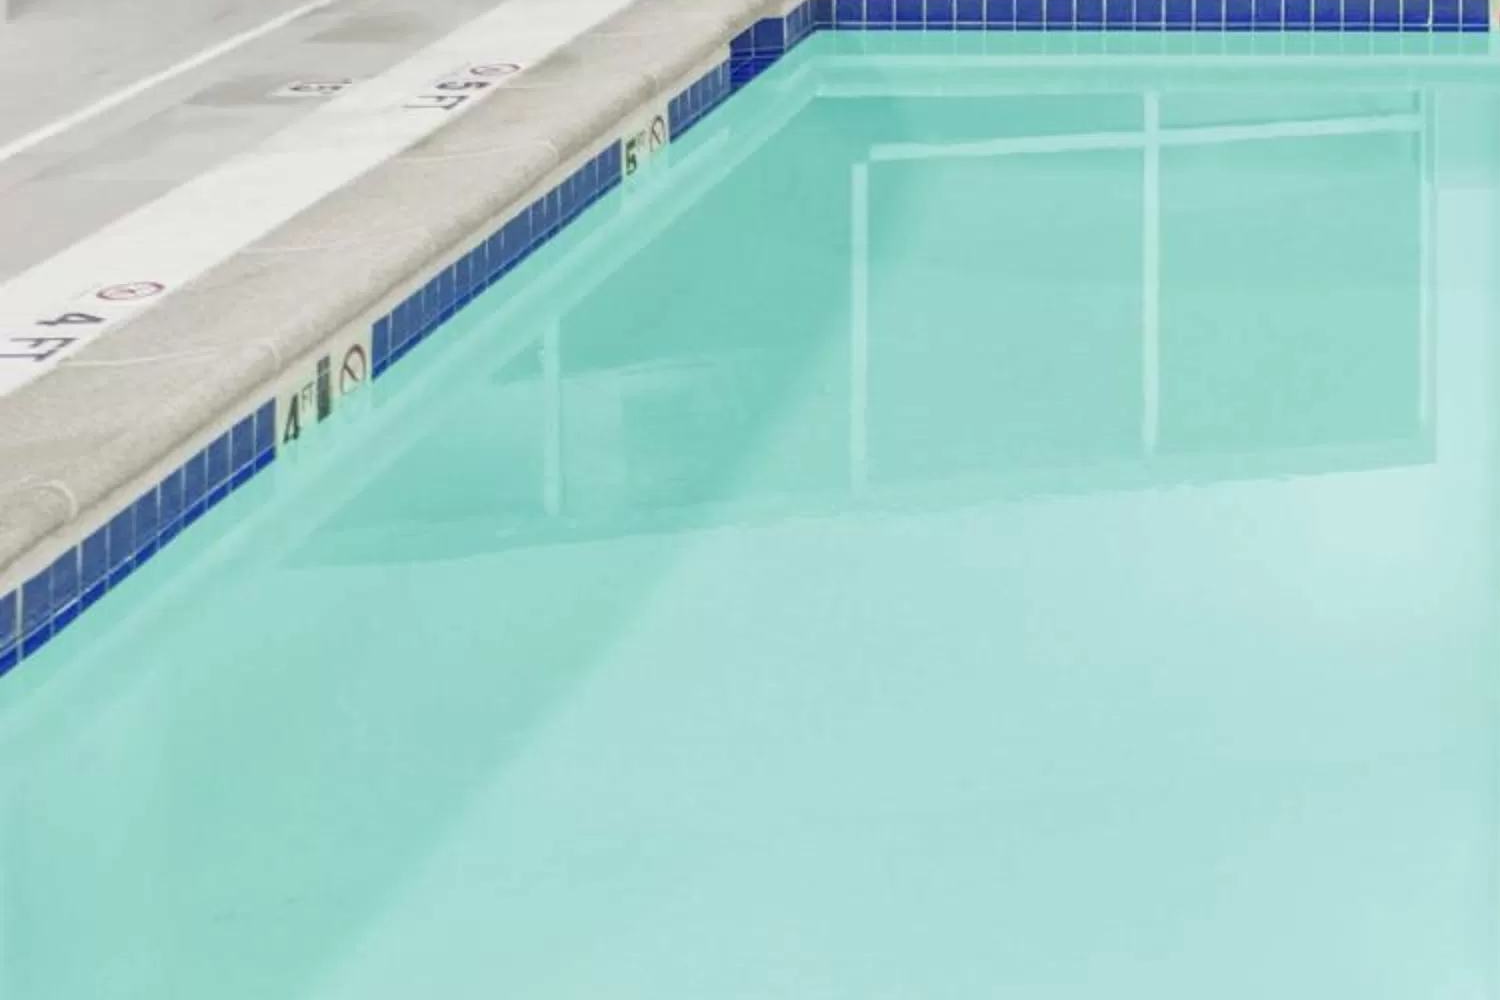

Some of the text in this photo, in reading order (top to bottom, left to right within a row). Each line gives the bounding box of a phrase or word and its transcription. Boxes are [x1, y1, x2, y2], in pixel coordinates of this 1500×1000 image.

[401, 95, 469, 109] FT
[625, 137, 637, 176] 5
[0, 312, 107, 362] 4 FT
[283, 391, 302, 444] 4
